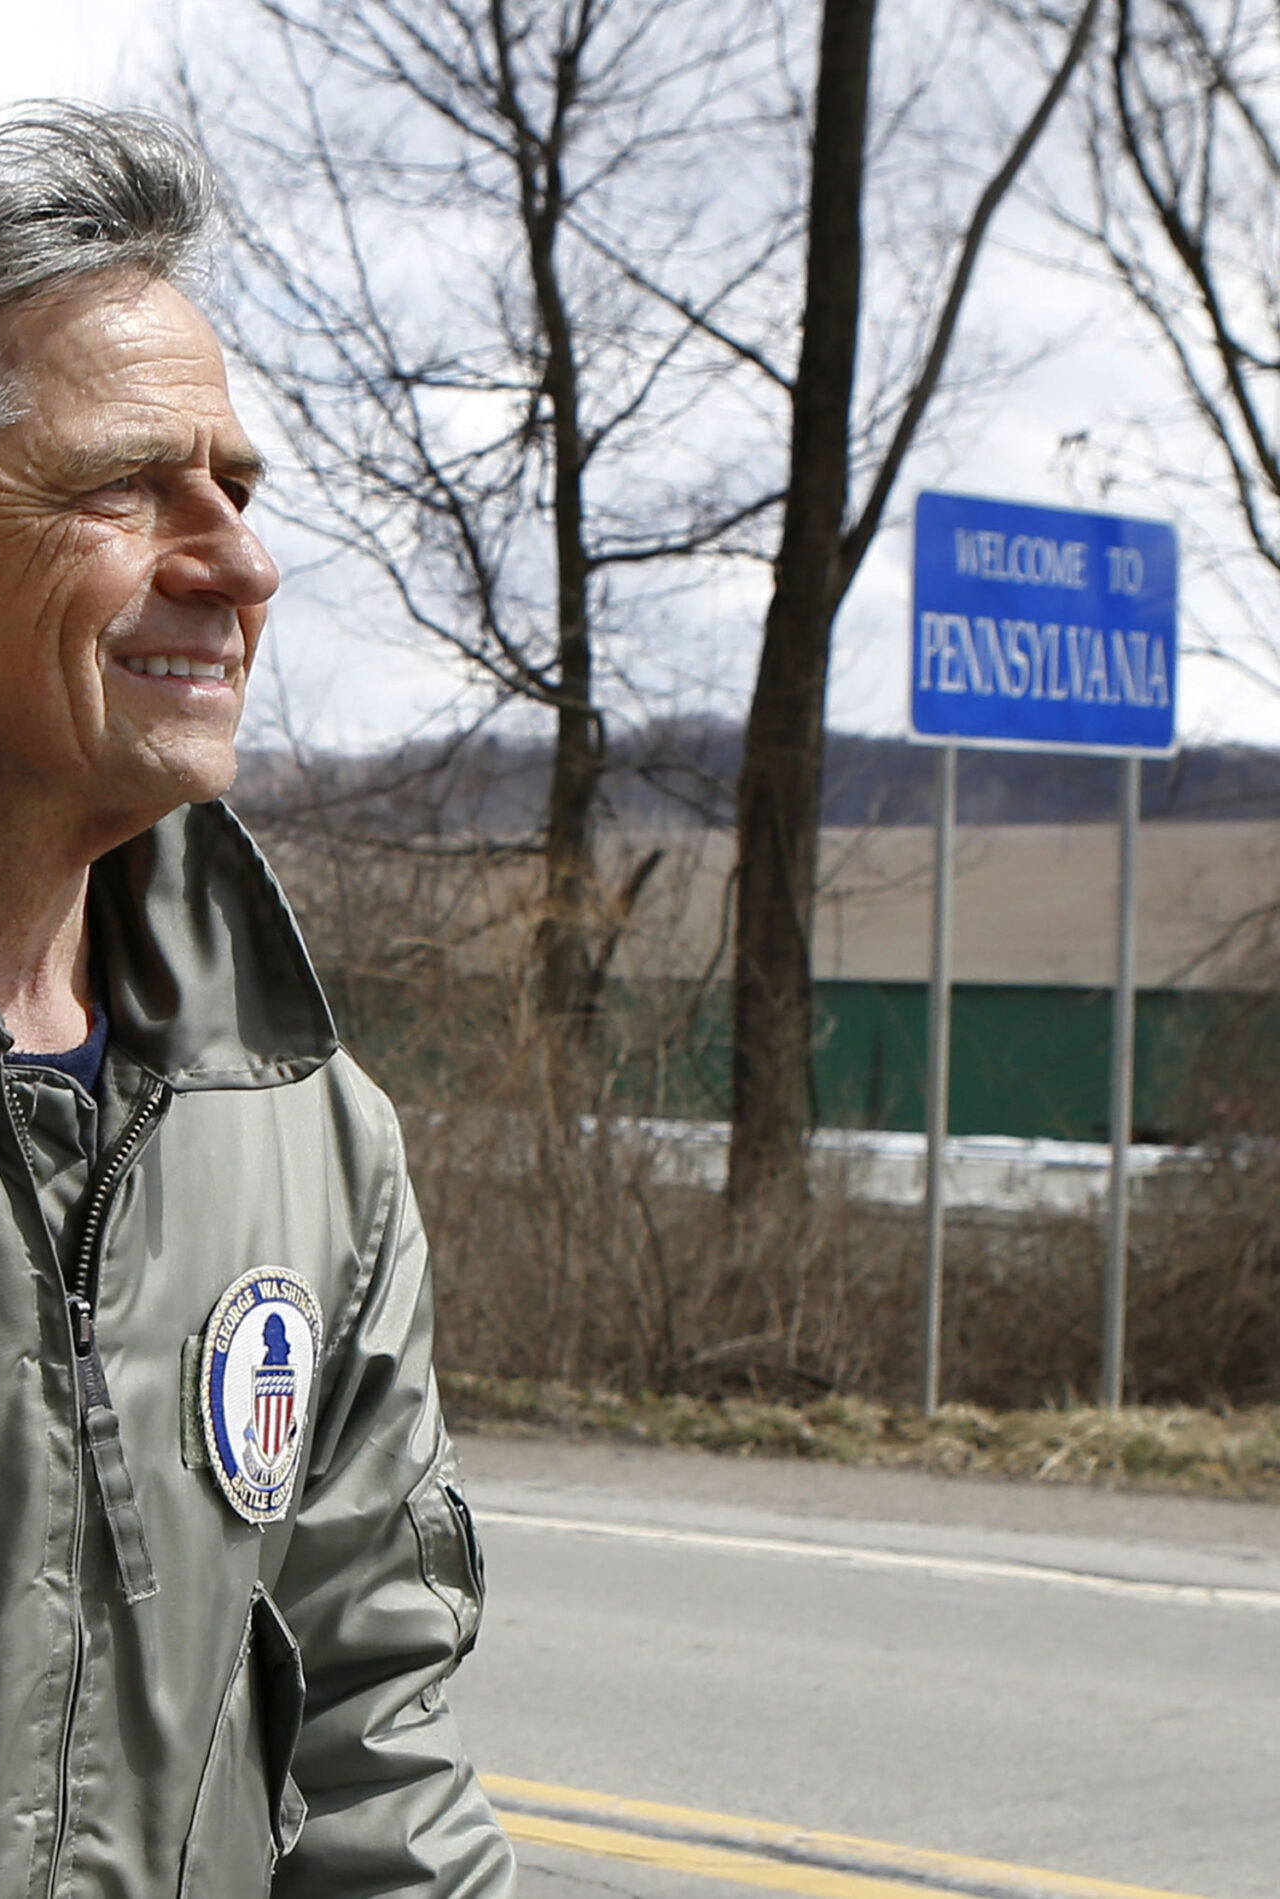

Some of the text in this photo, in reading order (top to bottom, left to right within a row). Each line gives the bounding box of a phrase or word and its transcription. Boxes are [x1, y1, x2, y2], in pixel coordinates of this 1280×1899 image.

[954, 527, 1144, 596] WELCOME TO
[920, 610, 1170, 708] PENNSYLVANIA
[215, 1280, 320, 1354] GEORGE WASHINGT
[231, 1469, 270, 1509] BATTLE
